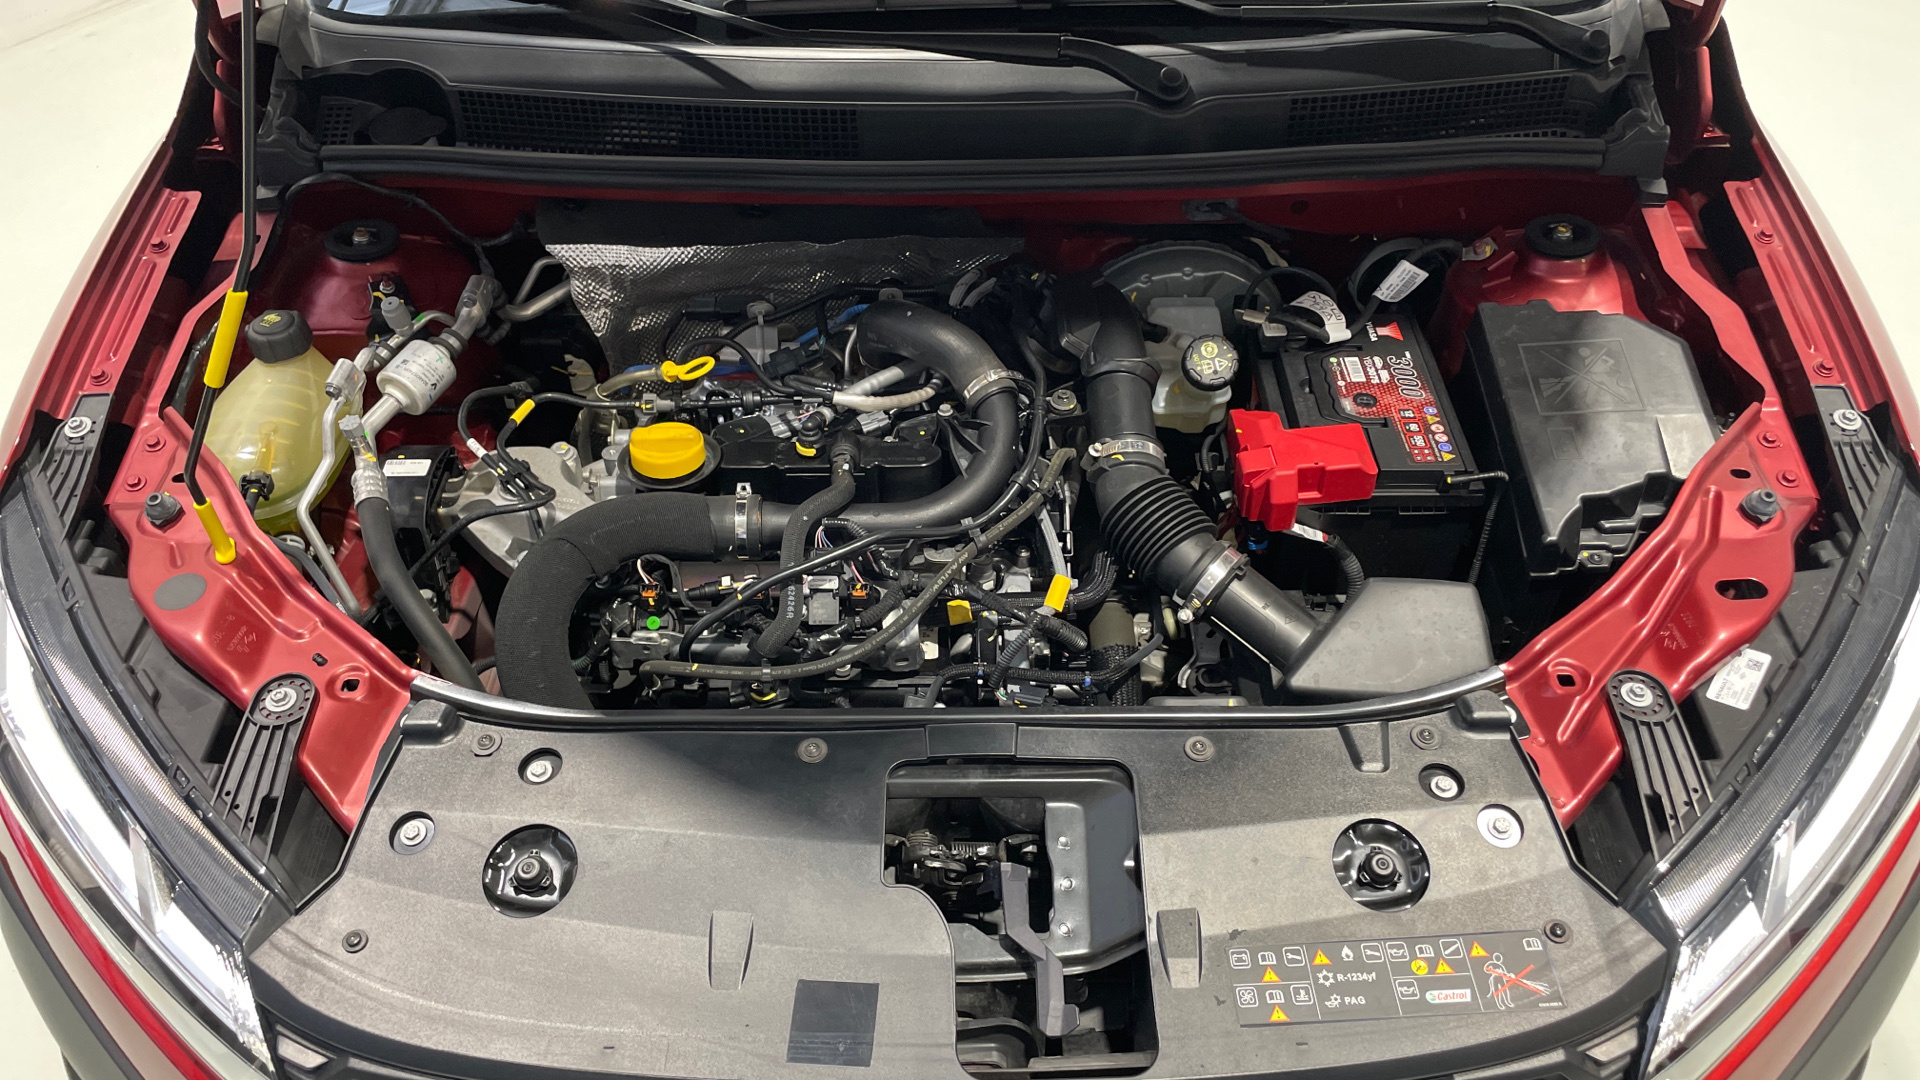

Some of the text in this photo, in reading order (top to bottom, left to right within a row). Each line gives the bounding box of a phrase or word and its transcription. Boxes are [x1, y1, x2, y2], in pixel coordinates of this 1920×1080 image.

[1365, 321, 1379, 342] YUASA
[1387, 355, 1426, 399] 3000
[1404, 409, 1415, 418] 12
[1413, 435, 1426, 447] 550
[1337, 971, 1377, 984] R-1234yf
[1343, 995, 1366, 1006] PAG
[1437, 990, 1468, 1002] Castrol
